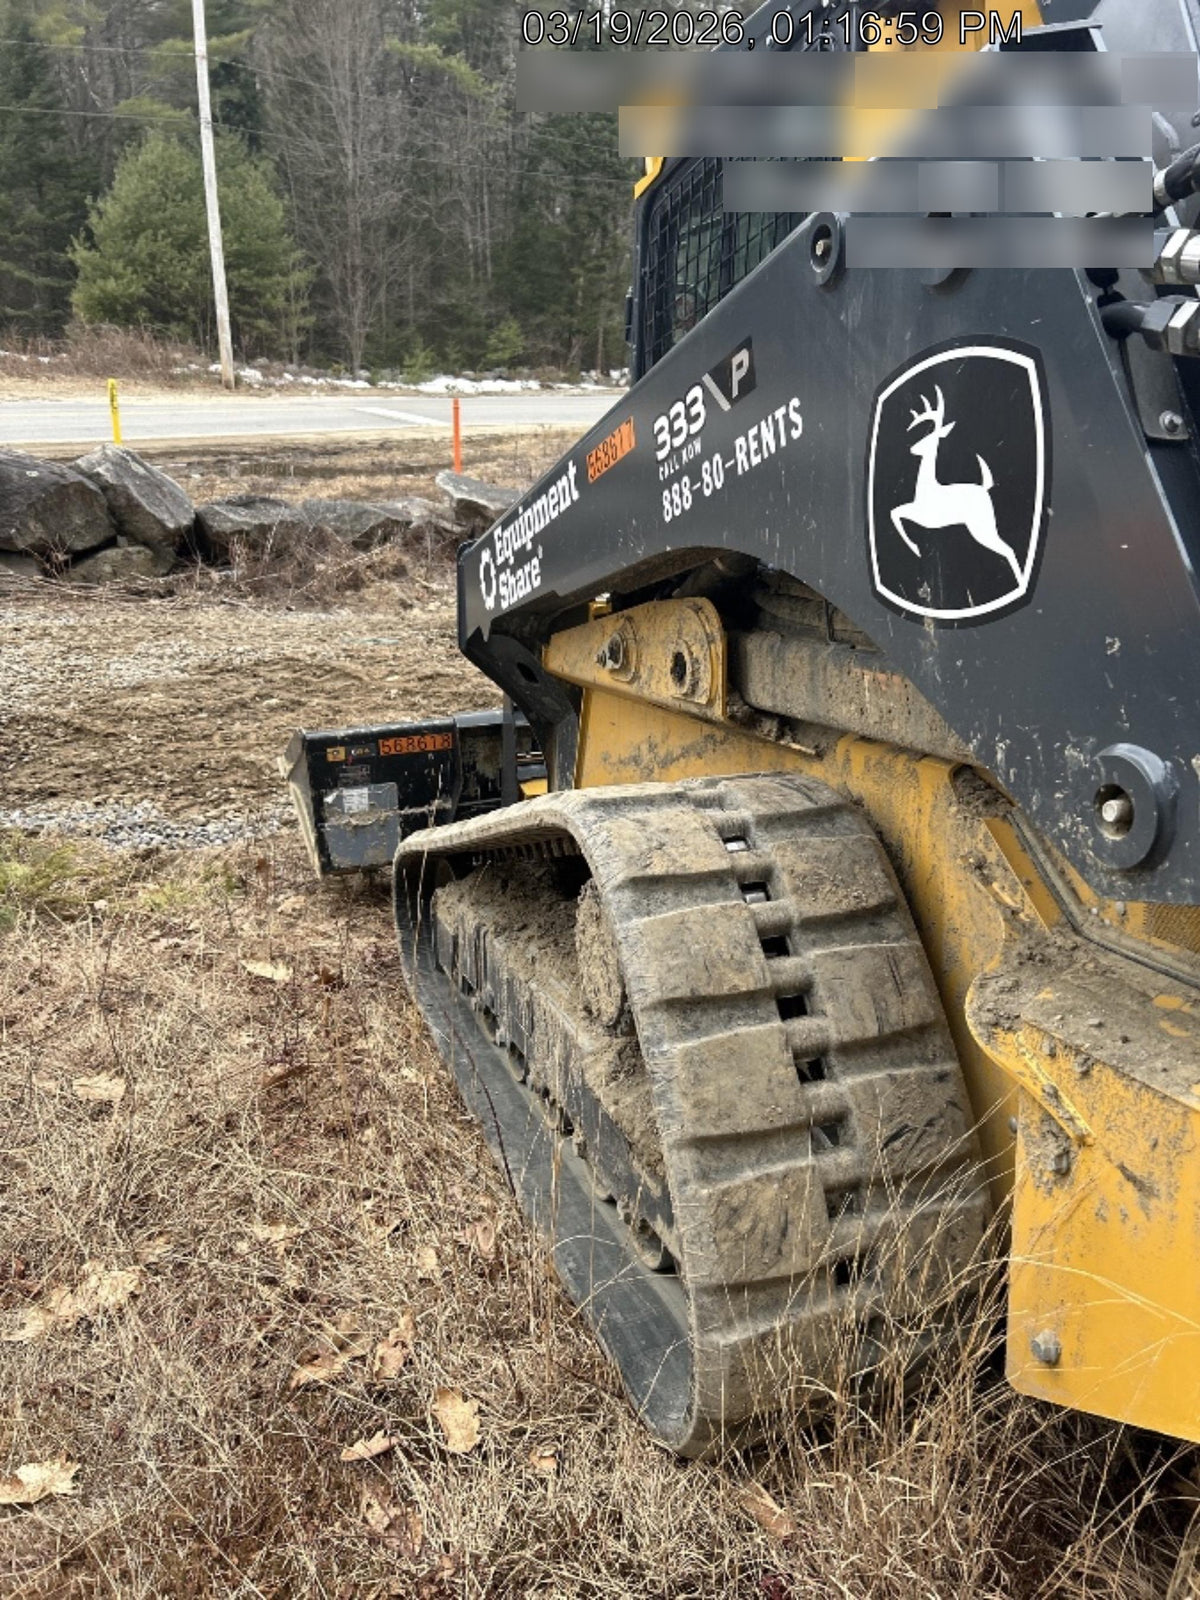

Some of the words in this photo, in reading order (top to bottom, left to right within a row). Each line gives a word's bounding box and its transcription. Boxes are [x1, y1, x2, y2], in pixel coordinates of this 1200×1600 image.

[653, 384, 707, 462] 333
[731, 348, 750, 399] P
[658, 454, 680, 482] CALL
[681, 436, 702, 466] NOW
[493, 459, 581, 567] Equipment
[661, 397, 803, 524] 888-80-RENTS
[498, 555, 543, 611] Share
